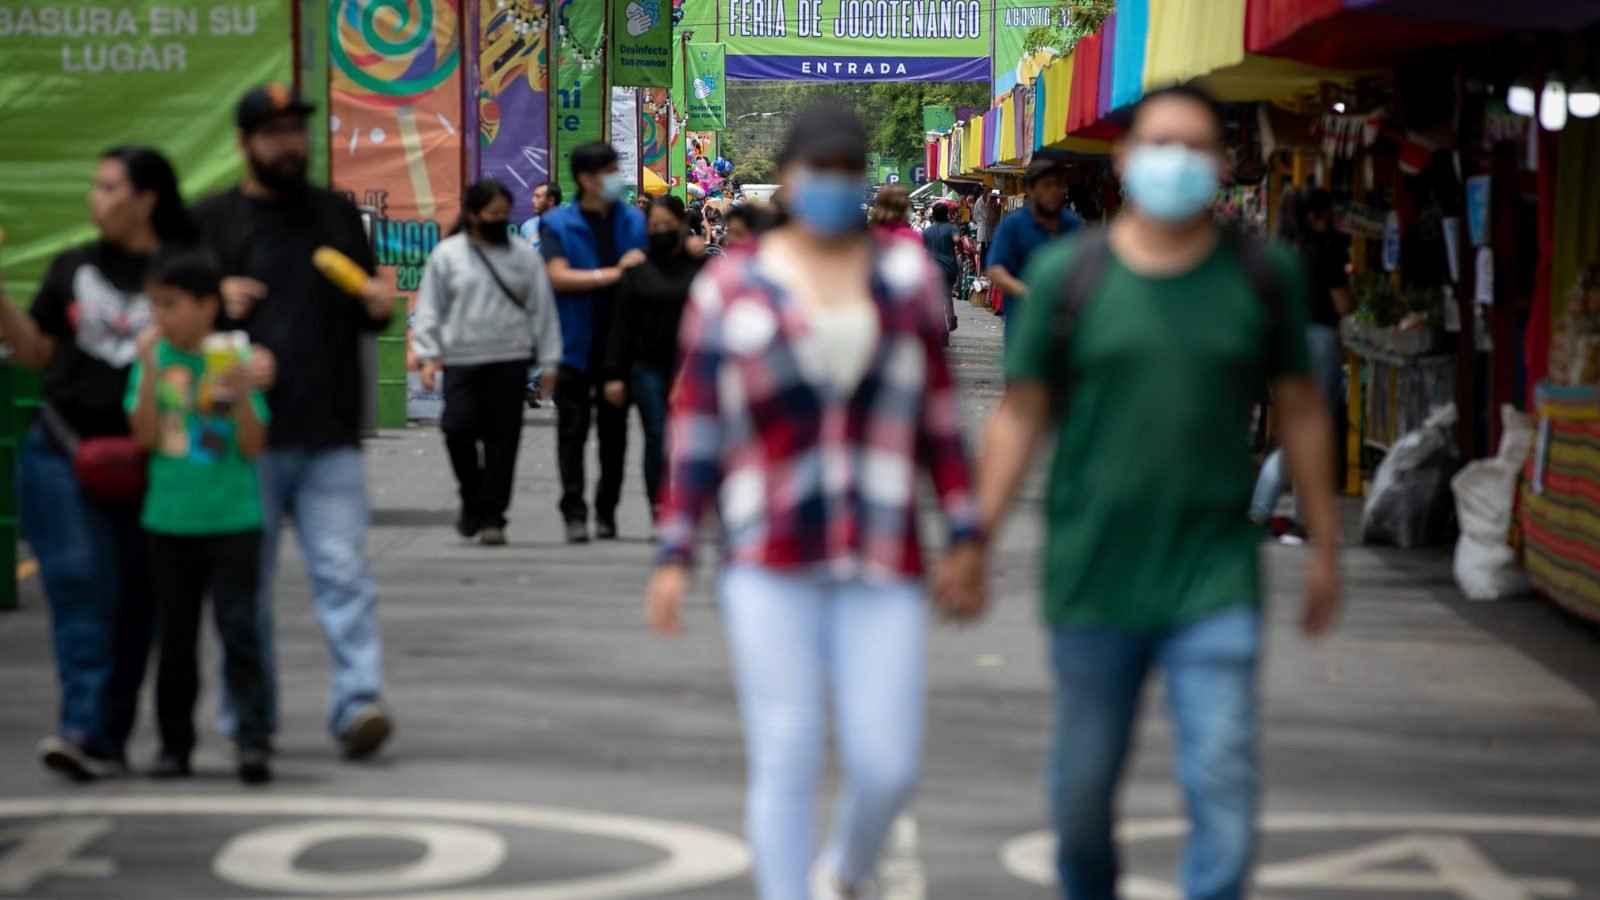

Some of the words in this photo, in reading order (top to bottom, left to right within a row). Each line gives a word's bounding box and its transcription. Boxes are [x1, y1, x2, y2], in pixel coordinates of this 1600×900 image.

[149, 7, 198, 36] EN
[208, 6, 257, 36] SU
[728, 0, 786, 37] FERIA
[798, 0, 822, 38] DE
[833, 0, 981, 39] JOCOTENANGO
[1005, 7, 1050, 27] AGOSTO
[61, 43, 188, 72] LUGAR
[620, 44, 668, 55] Desinfecta
[621, 57, 635, 66] tus
[636, 58, 667, 68] manos
[801, 62, 907, 75] ENTRADA
